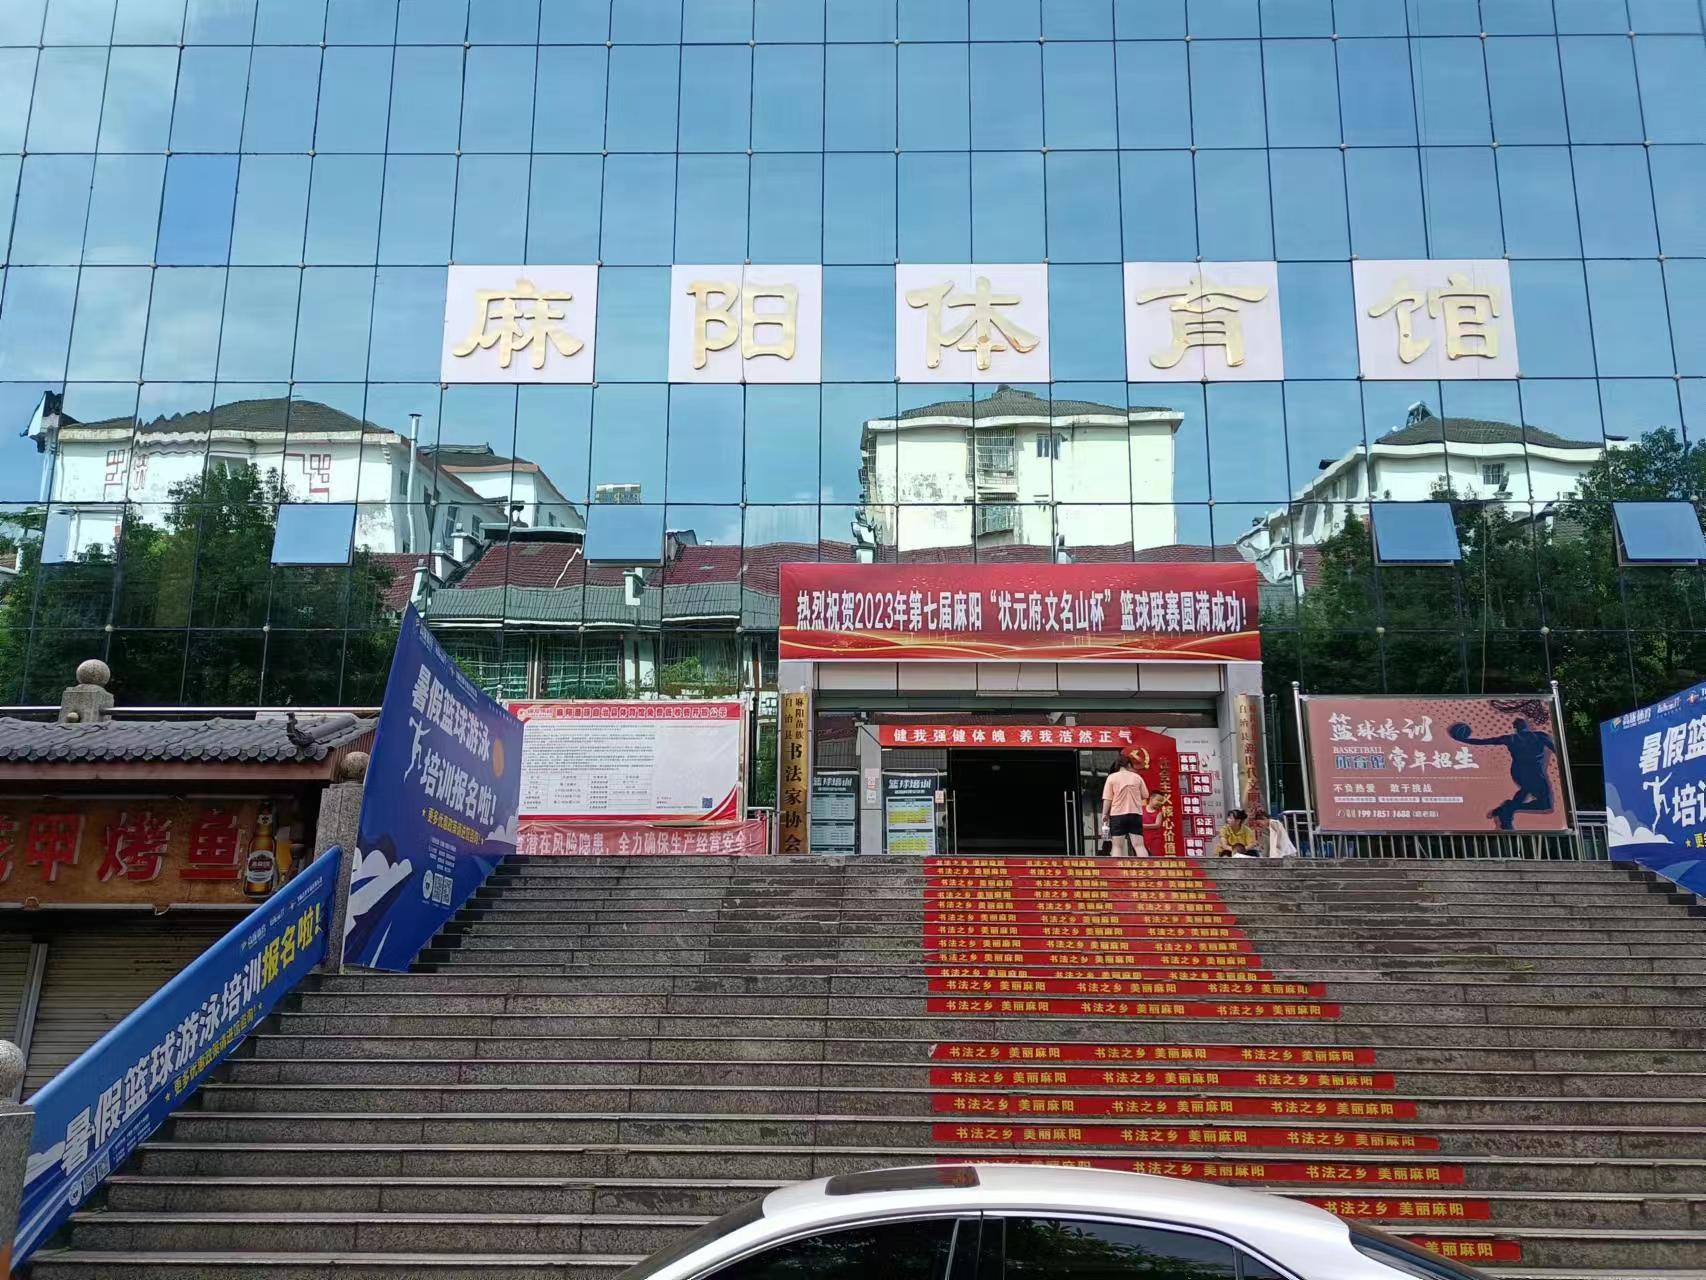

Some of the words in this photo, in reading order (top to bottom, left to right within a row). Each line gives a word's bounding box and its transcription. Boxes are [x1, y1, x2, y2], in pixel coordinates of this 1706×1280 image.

[453, 273, 1500, 370] 麻阳体育馆
[412, 664, 490, 761] 暑假篮球游泳
[784, 697, 793, 739] 自治县
[795, 697, 804, 739] 麻阳苗族
[1328, 712, 1433, 742] 篮球培训
[894, 728, 1006, 743] 健我强健体魄
[1019, 729, 1132, 744] 养我浩然正气
[1333, 746, 1384, 754] BASKETBALL
[1335, 755, 1386, 769] 体育馆
[1388, 746, 1479, 773] 常年招生
[420, 748, 497, 826] 培训报名啦!
[784, 742, 803, 853] 书法家协会
[1159, 758, 1176, 857] 社会主义核心价值
[1196, 817, 1213, 826] 公正
[939, 926, 974, 934] 书法之乡
[981, 926, 1017, 934] 美丽麻阳
[1043, 927, 1079, 935] 书法之乡
[1086, 928, 1122, 936] 美丽麻阳
[1148, 928, 1184, 936] 书法之乡
[1191, 928, 1228, 936] 美丽麻阳
[1047, 940, 1084, 949] 书法之乡
[1091, 941, 1128, 950] 美丽麻阳
[1155, 943, 1192, 951] 书法之乡
[1199, 943, 1237, 951] 美丽麻阳
[940, 953, 977, 961] 书法之乡
[984, 953, 1023, 962] 美丽麻阳
[1050, 955, 1088, 963] 书法之乡
[1095, 955, 1134, 964] 美丽麻阳
[1161, 956, 1199, 965] 书法之乡
[1206, 956, 1246, 965] 美丽麻阳
[947, 980, 992, 990] 书法之乡
[1000, 981, 1046, 991] 美丽麻阳
[1077, 982, 1122, 993] 书法之乡
[1130, 983, 1177, 993] 美丽麻阳
[1208, 983, 1254, 993] 书法之乡
[1261, 984, 1308, 994] 美丽麻阳
[946, 1000, 993, 1011] 书法之乡
[1001, 1001, 1049, 1012] 美丽麻阳
[1081, 1002, 1128, 1013] 书法之乡
[1136, 1003, 1185, 1014] 美丽麻阳
[1216, 1005, 1265, 1016] 书法之乡
[1273, 1005, 1321, 1016] 美丽麻阳
[949, 1046, 1000, 1058] 书法之乡
[1009, 1047, 1060, 1058] 美丽麻阳
[1095, 1047, 1146, 1059] 书法之乡
[1155, 1048, 1207, 1059] 美丽麻阳
[1241, 1049, 1293, 1061] 书法之乡
[1301, 1050, 1354, 1062] 美丽麻阳
[951, 1071, 1003, 1083] 书法之乡
[1013, 1071, 1067, 1083] 美丽麻阳
[1102, 1072, 1155, 1083] 书法之乡
[1165, 1072, 1219, 1084] 美丽麻阳
[1255, 1073, 1309, 1085] 书法之乡
[1318, 1075, 1373, 1086] 美丽麻阳
[953, 1097, 1008, 1110] 书法之乡
[1018, 1099, 1074, 1111] 美丽麻阳
[1112, 1101, 1167, 1113] 书法之乡
[1176, 1101, 1233, 1113] 美丽麻阳
[1271, 1101, 1327, 1114] 书法之乡
[1336, 1103, 1394, 1115] 美丽麻阳
[956, 1127, 1013, 1139] 书法之乡
[1023, 1128, 1081, 1140] 美丽麻阳
[1120, 1129, 1178, 1141] 书法之乡
[1188, 1130, 1247, 1142] 美丽麻阳
[1287, 1132, 1345, 1145] 书法之乡
[1355, 1134, 1415, 1147] 美丽麻阳
[1133, 1161, 1192, 1175] 书法之乡
[1203, 1163, 1265, 1177] 美丽麻阳
[1306, 1165, 1367, 1179] 书法之乡
[1378, 1167, 1441, 1180] 美丽麻阳
[1325, 1201, 1388, 1214] 书法之乡
[1399, 1202, 1465, 1216] 美丽麻阳
[1424, 1240, 1493, 1257] 美丽麻阳
